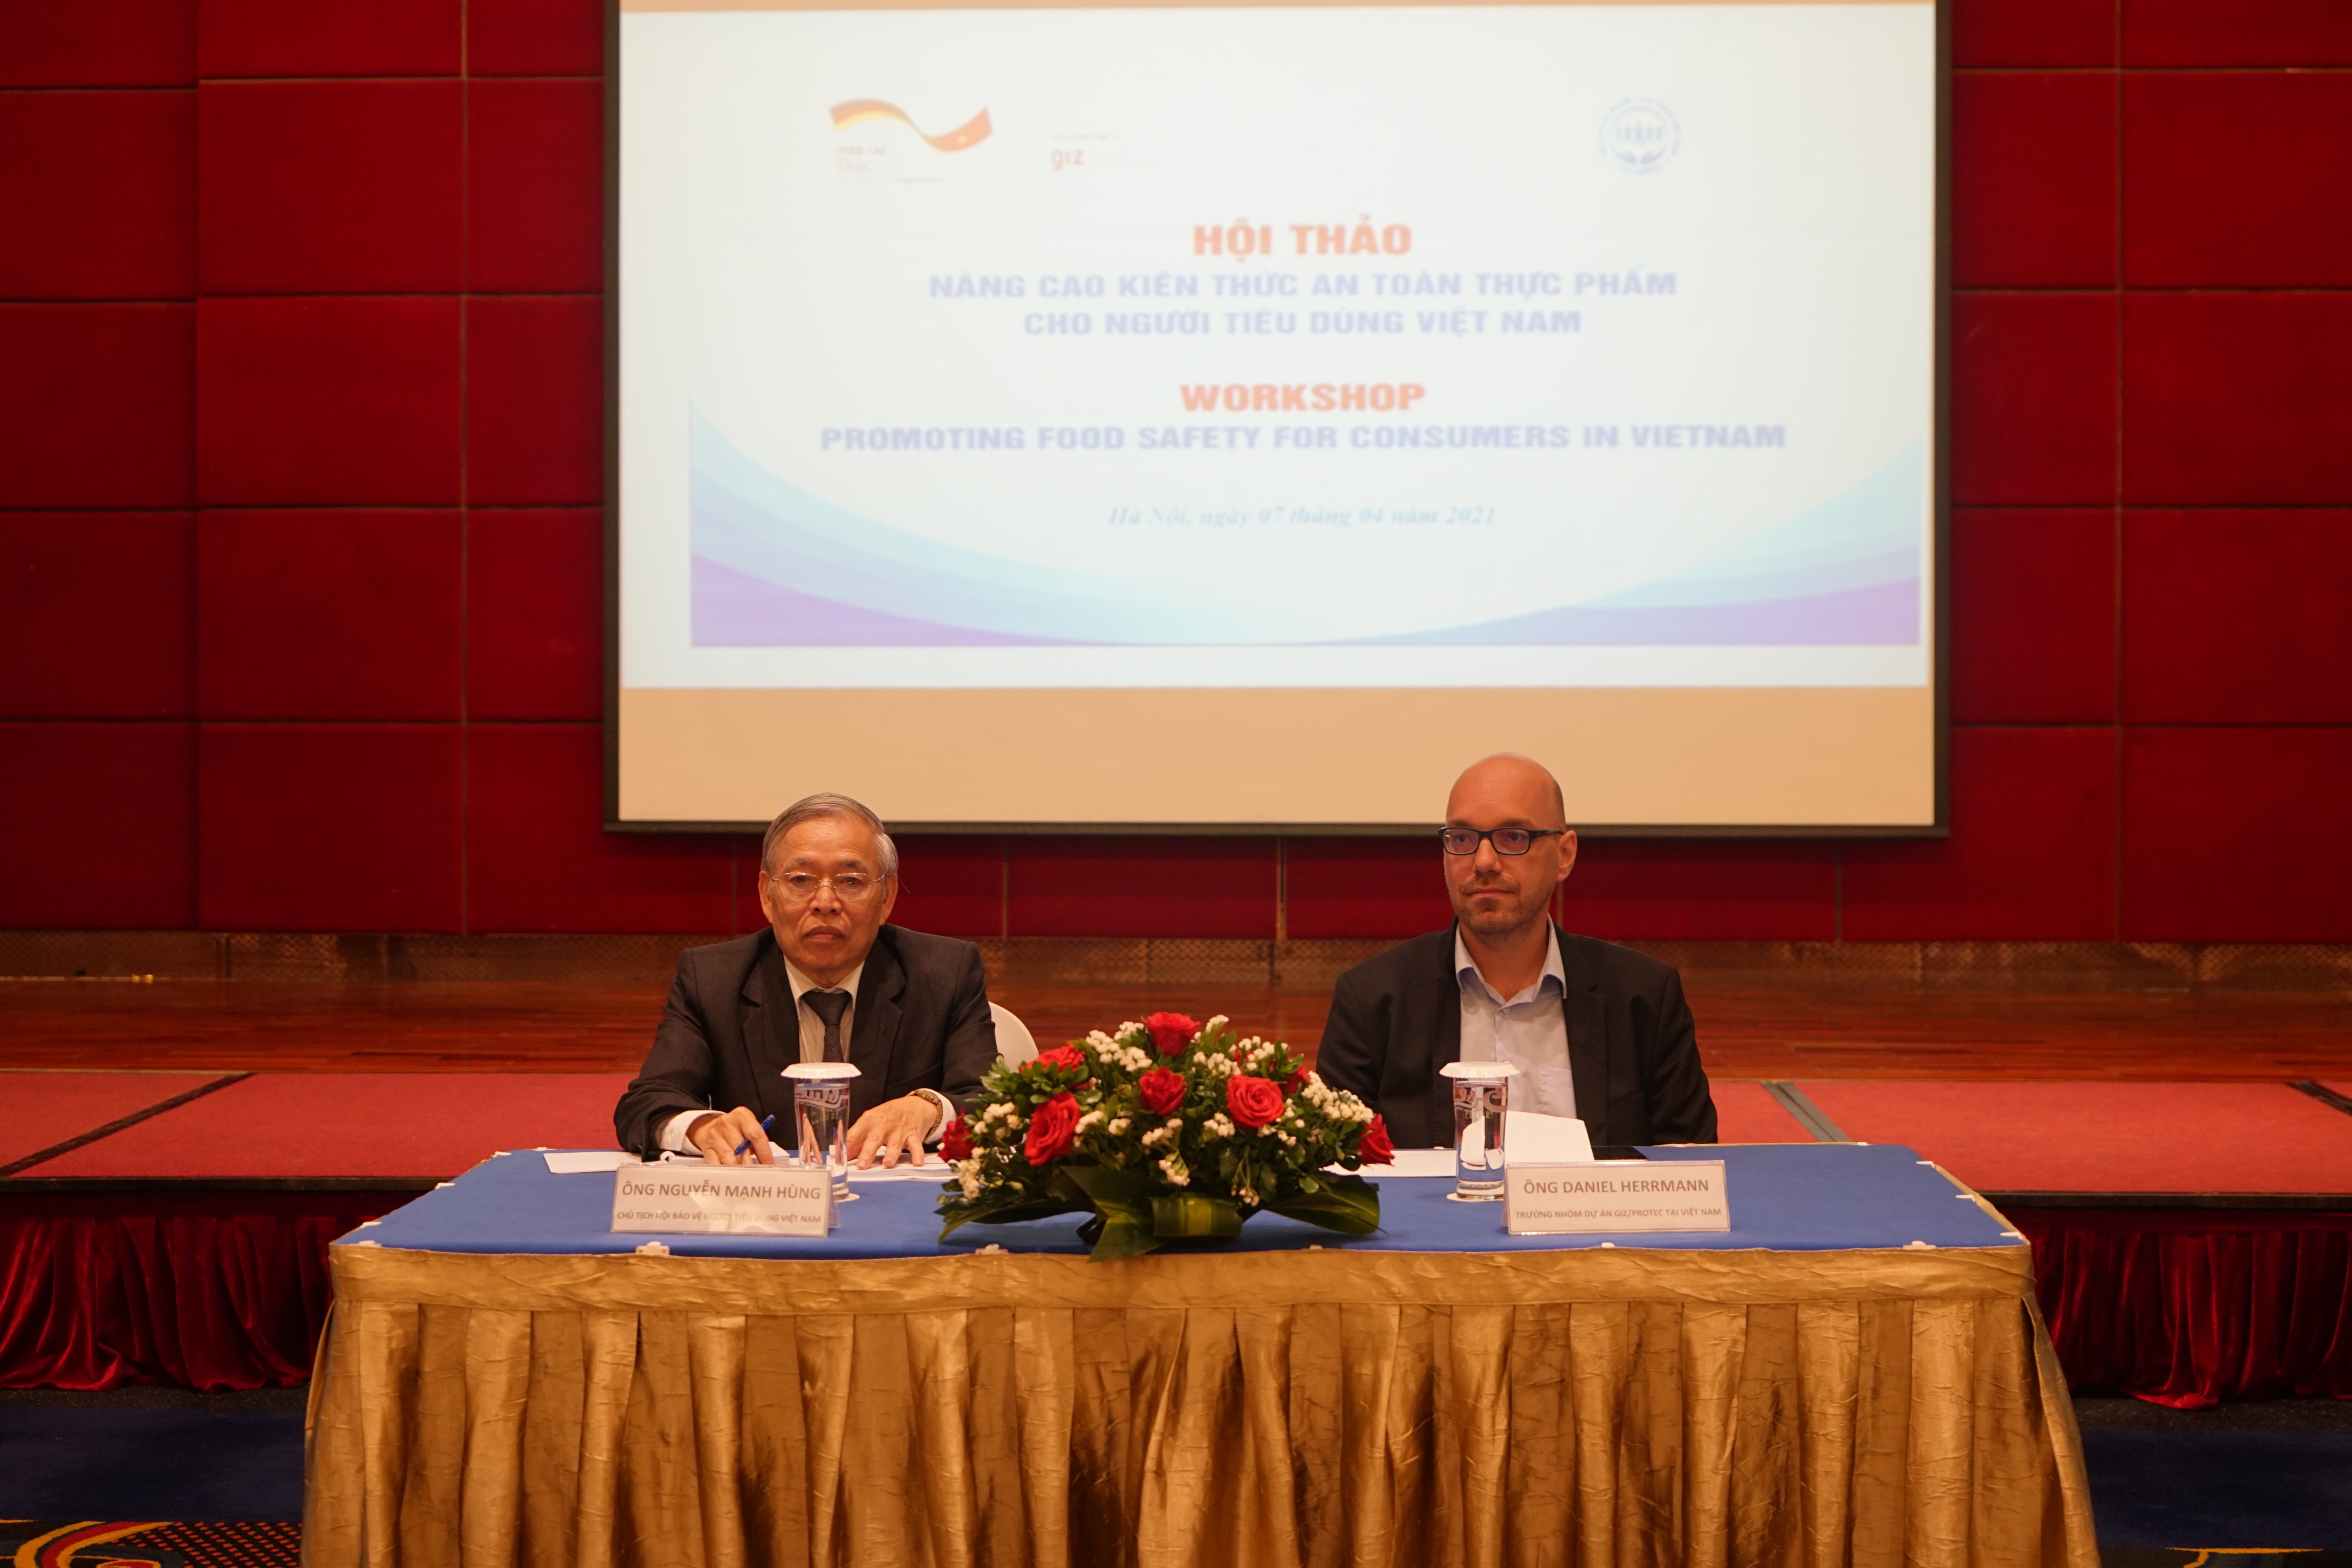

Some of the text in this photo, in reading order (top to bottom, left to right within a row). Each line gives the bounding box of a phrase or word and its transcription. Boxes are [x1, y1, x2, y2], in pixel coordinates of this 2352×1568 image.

[1193, 214, 1412, 263] HỘI THẢO
[929, 270, 1026, 298] NÂNG
[1039, 274, 1105, 297] CAO
[1212, 270, 1298, 296] THỨC
[1311, 273, 1358, 296] AN
[1370, 269, 1462, 296] TOÀN
[1475, 271, 1562, 300] THỰC
[1024, 306, 1582, 337] CHO NGƯỜI TIÊU DÙNG VIỆT NAM
[1179, 384, 1425, 412] WORKSHOP
[821, 424, 1786, 451] PROMOTING FOOD SAFETY FOR CONSUMERS IN VIETNAM
[1108, 506, 1141, 525] Hà
[1199, 506, 1251, 528] ngày
[1258, 506, 1284, 524] 07
[1290, 506, 1352, 528] tháng
[1359, 506, 1383, 524] 04
[1390, 506, 1438, 524] năm
[1446, 506, 1495, 524] 2021
[622, 1180, 821, 1200] ÔNG NGUYỄN MẠNH HÙNG
[1524, 1179, 1709, 1194] ÔNG DANIEL HERRMANN
[617, 1210, 634, 1219] CHỦ
[636, 1212, 654, 1220] TỊCH
[673, 1210, 689, 1219] BẢO
[692, 1211, 702, 1221] VỆ
[781, 1213, 798, 1224] VIỆT
[1515, 1209, 1552, 1219] TRƯỞNG
[1555, 1208, 1582, 1218] NHÓM
[1584, 1209, 1598, 1219] DỰ
[1600, 1208, 1612, 1217] ÁN
[1614, 1208, 1663, 1218] GIZ/PROTEC
[1666, 1208, 1679, 1218] TẠI
[1681, 1207, 1699, 1217] VIỆT
